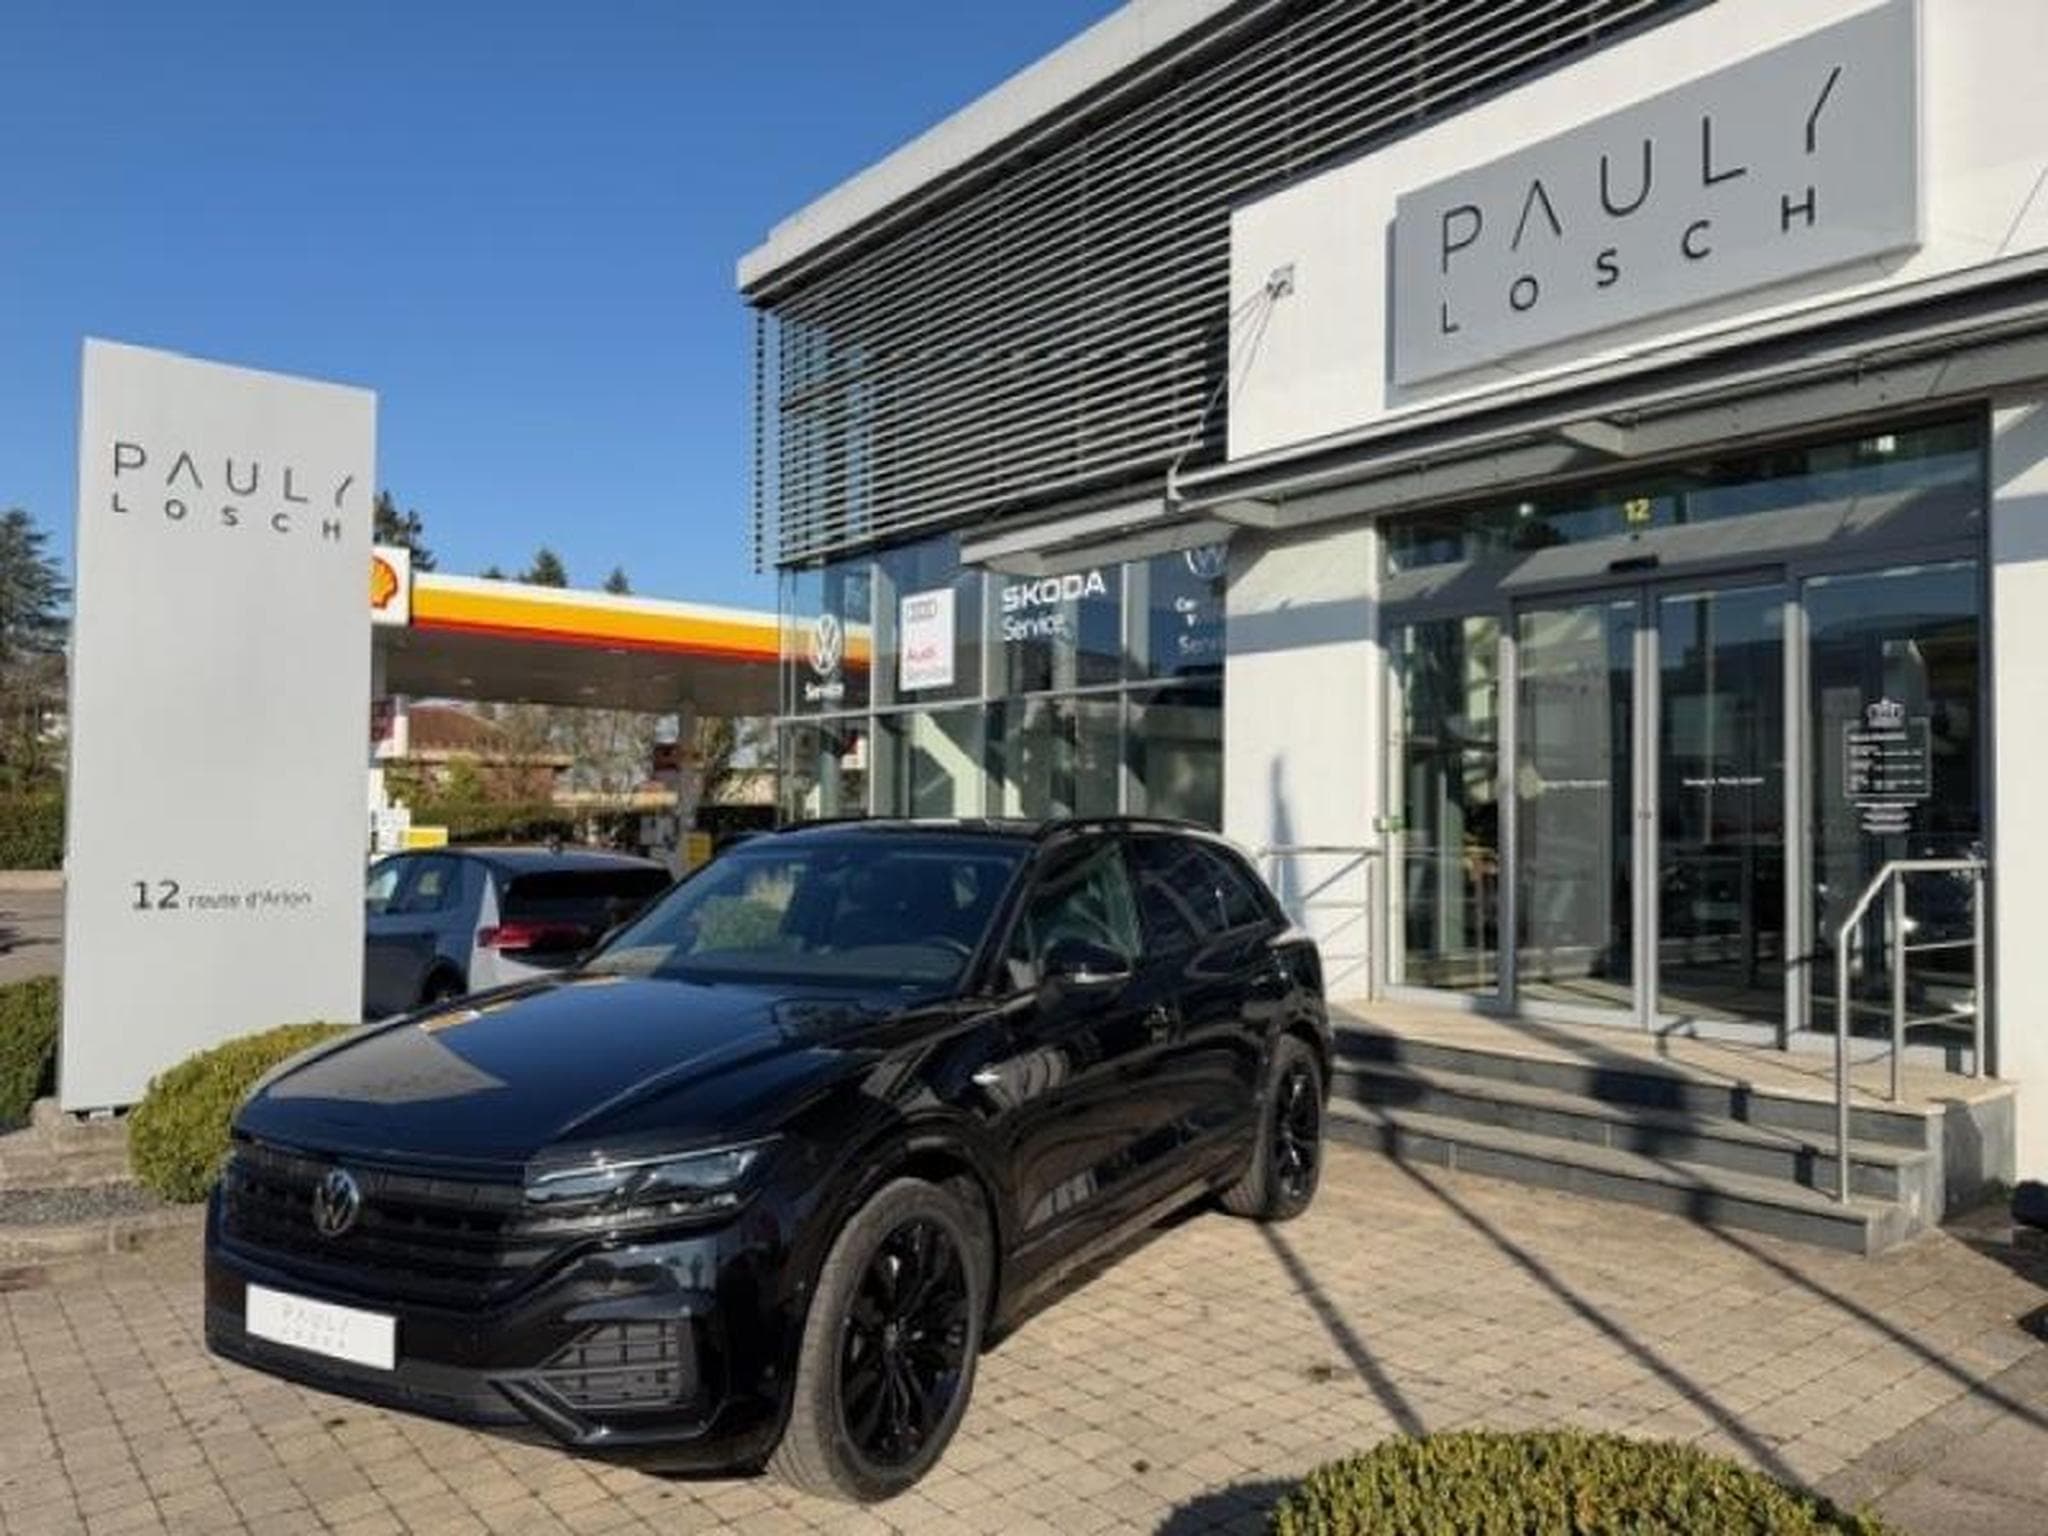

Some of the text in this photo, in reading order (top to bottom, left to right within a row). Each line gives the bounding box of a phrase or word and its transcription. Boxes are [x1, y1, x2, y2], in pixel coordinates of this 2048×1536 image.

[1441, 65, 1841, 274] PAULY
[1440, 186, 1816, 335] LOSCH
[113, 441, 353, 508] PAULY
[112, 492, 341, 540] LOSCH
[1002, 613, 1067, 641] Service
[132, 879, 180, 910] 12
